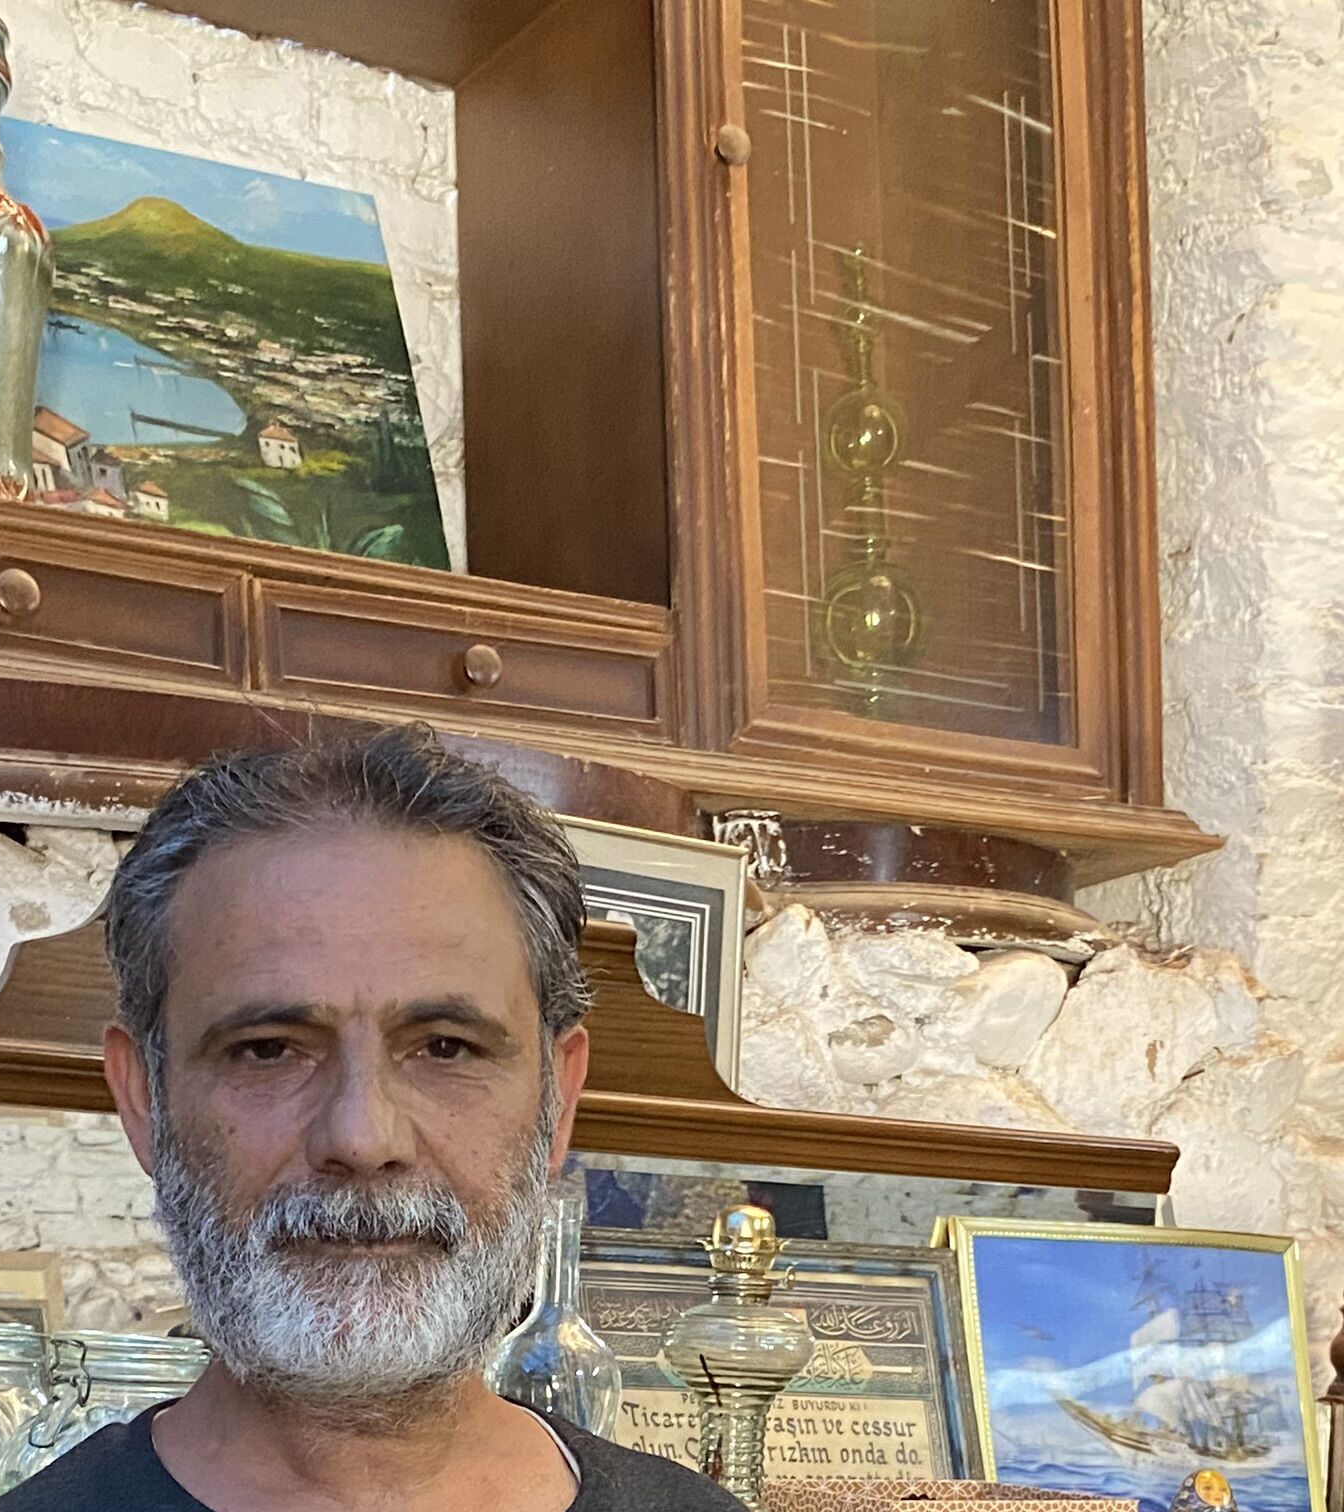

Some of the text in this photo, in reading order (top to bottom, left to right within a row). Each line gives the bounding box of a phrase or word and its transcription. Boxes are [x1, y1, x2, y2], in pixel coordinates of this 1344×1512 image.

[792, 1399, 845, 1411] BUYURDU
[621, 1401, 698, 1429] Ticare
[822, 1418, 845, 1435] ve
[851, 1420, 916, 1438] cessur
[840, 1442, 888, 1465] onda
